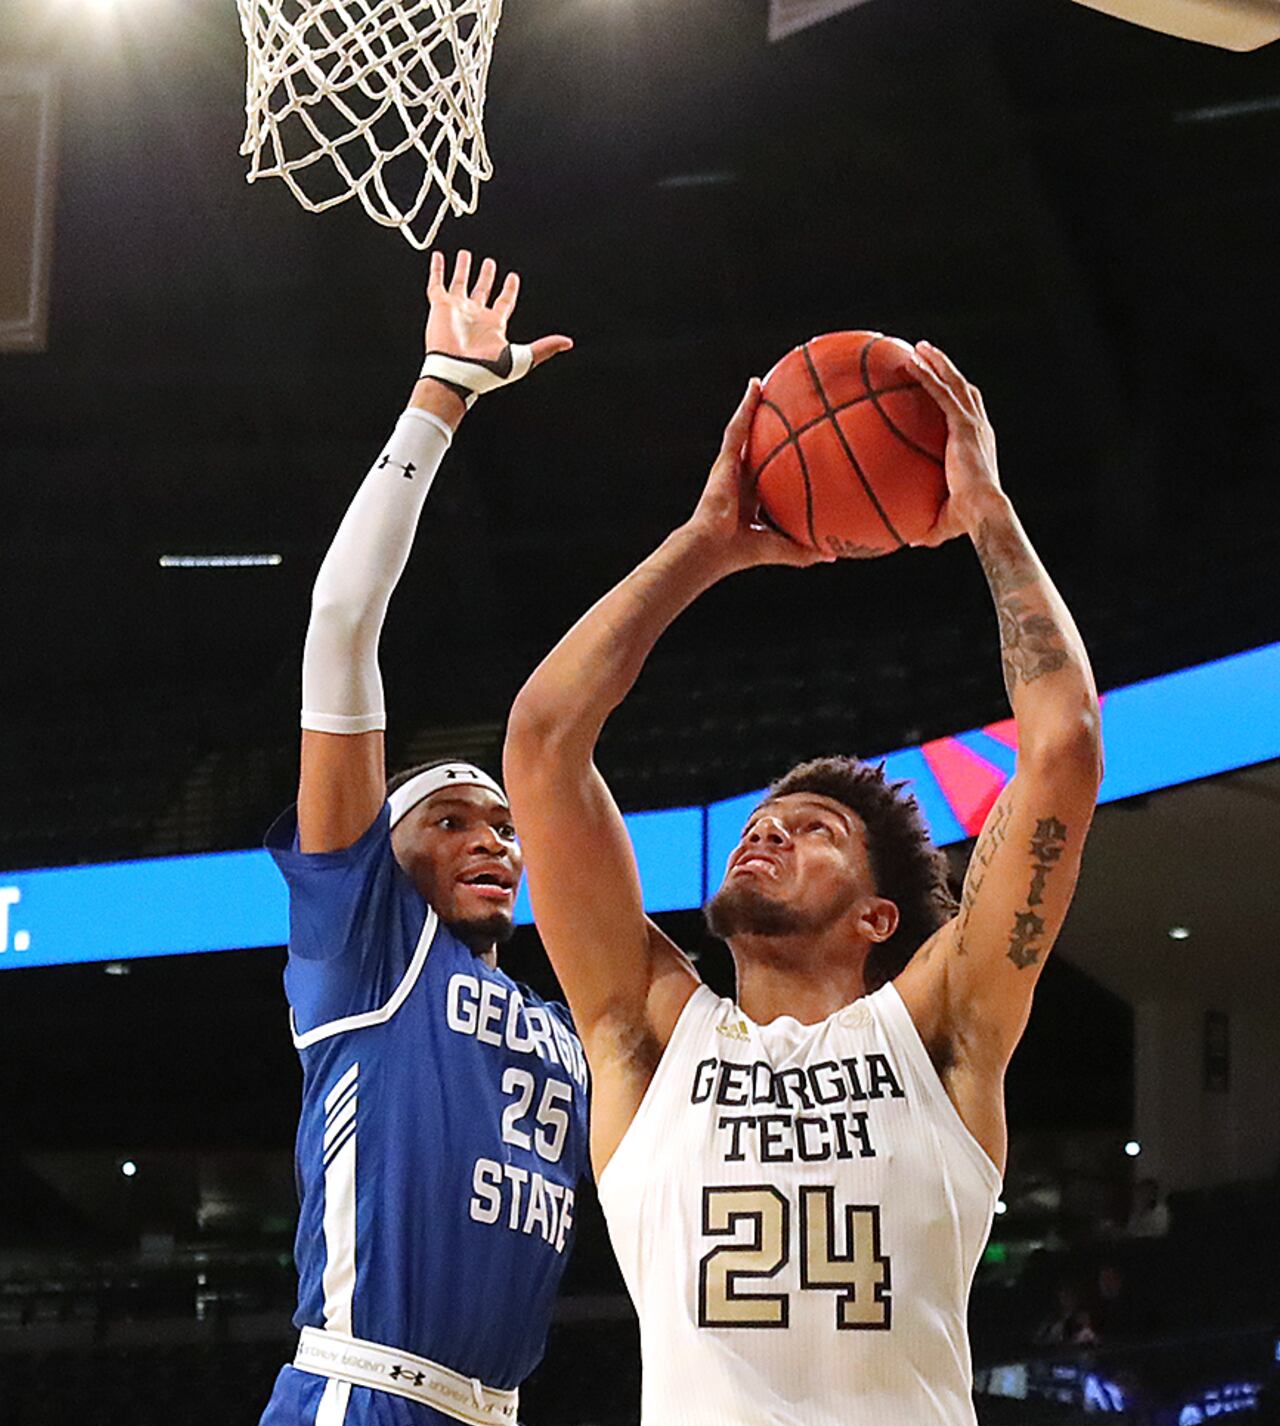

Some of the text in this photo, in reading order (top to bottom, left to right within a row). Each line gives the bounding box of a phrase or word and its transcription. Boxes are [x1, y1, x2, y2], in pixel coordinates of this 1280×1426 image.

[502, 1067, 572, 1163] 25
[691, 1053, 905, 1110] GEORGIA
[718, 1111, 876, 1163] TECH
[698, 1184, 892, 1331] 24
